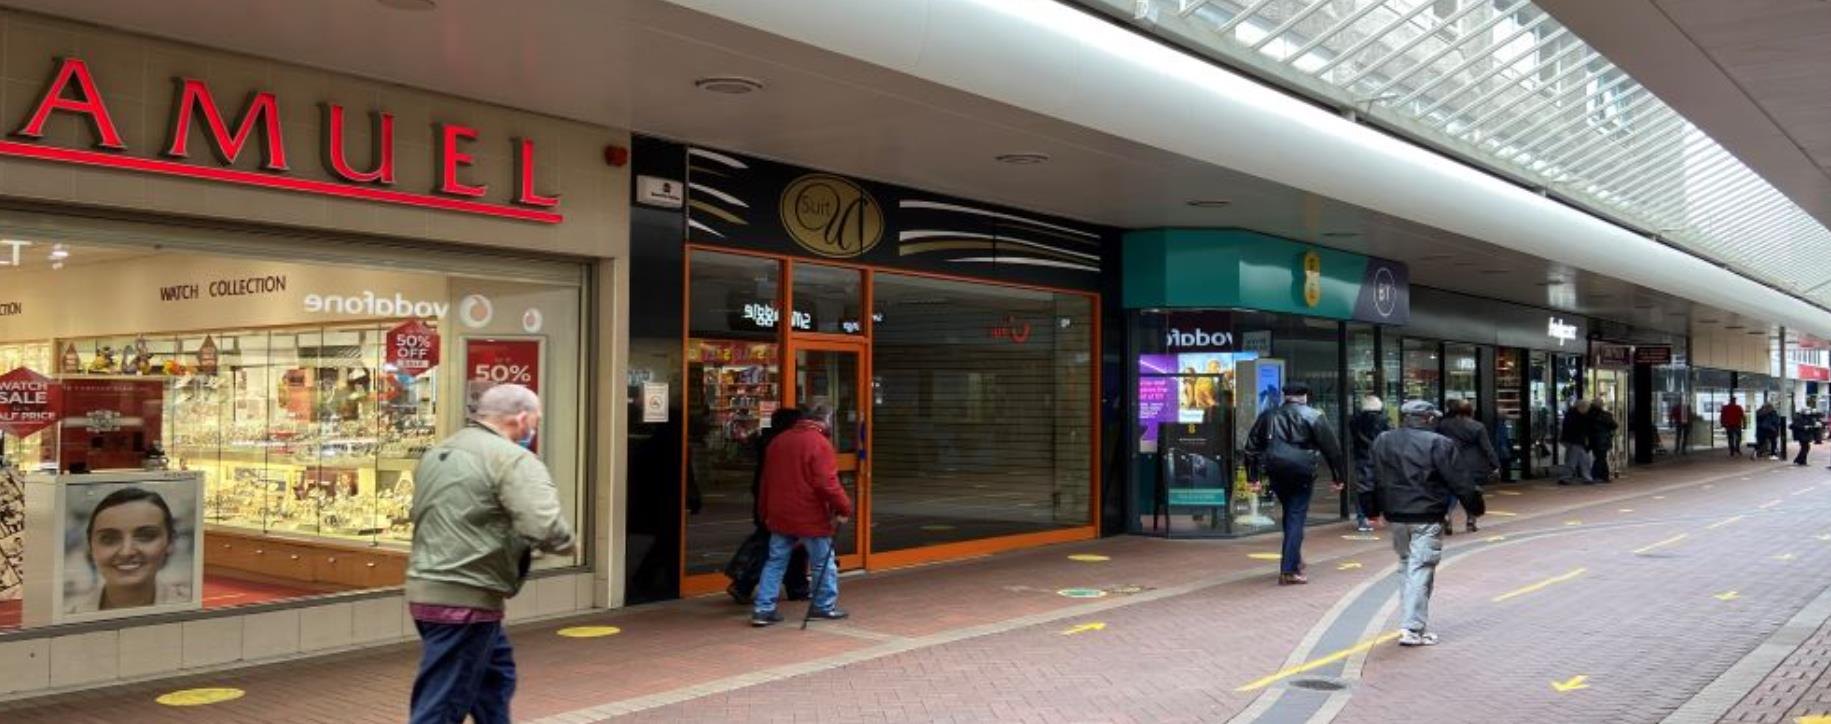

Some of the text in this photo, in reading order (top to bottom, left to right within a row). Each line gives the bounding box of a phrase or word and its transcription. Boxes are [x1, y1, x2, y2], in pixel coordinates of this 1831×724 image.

[14, 57, 562, 207] AMUEL
[160, 276, 286, 301] WATCH COLLECTION
[1379, 283, 1391, 301] BT
[396, 333, 431, 348] 50%
[397, 348, 428, 359] OFF
[475, 364, 532, 382] 50%
[0, 382, 48, 391] WATCH
[0, 391, 47, 404] SALE
[21, 412, 56, 420] PRICE
